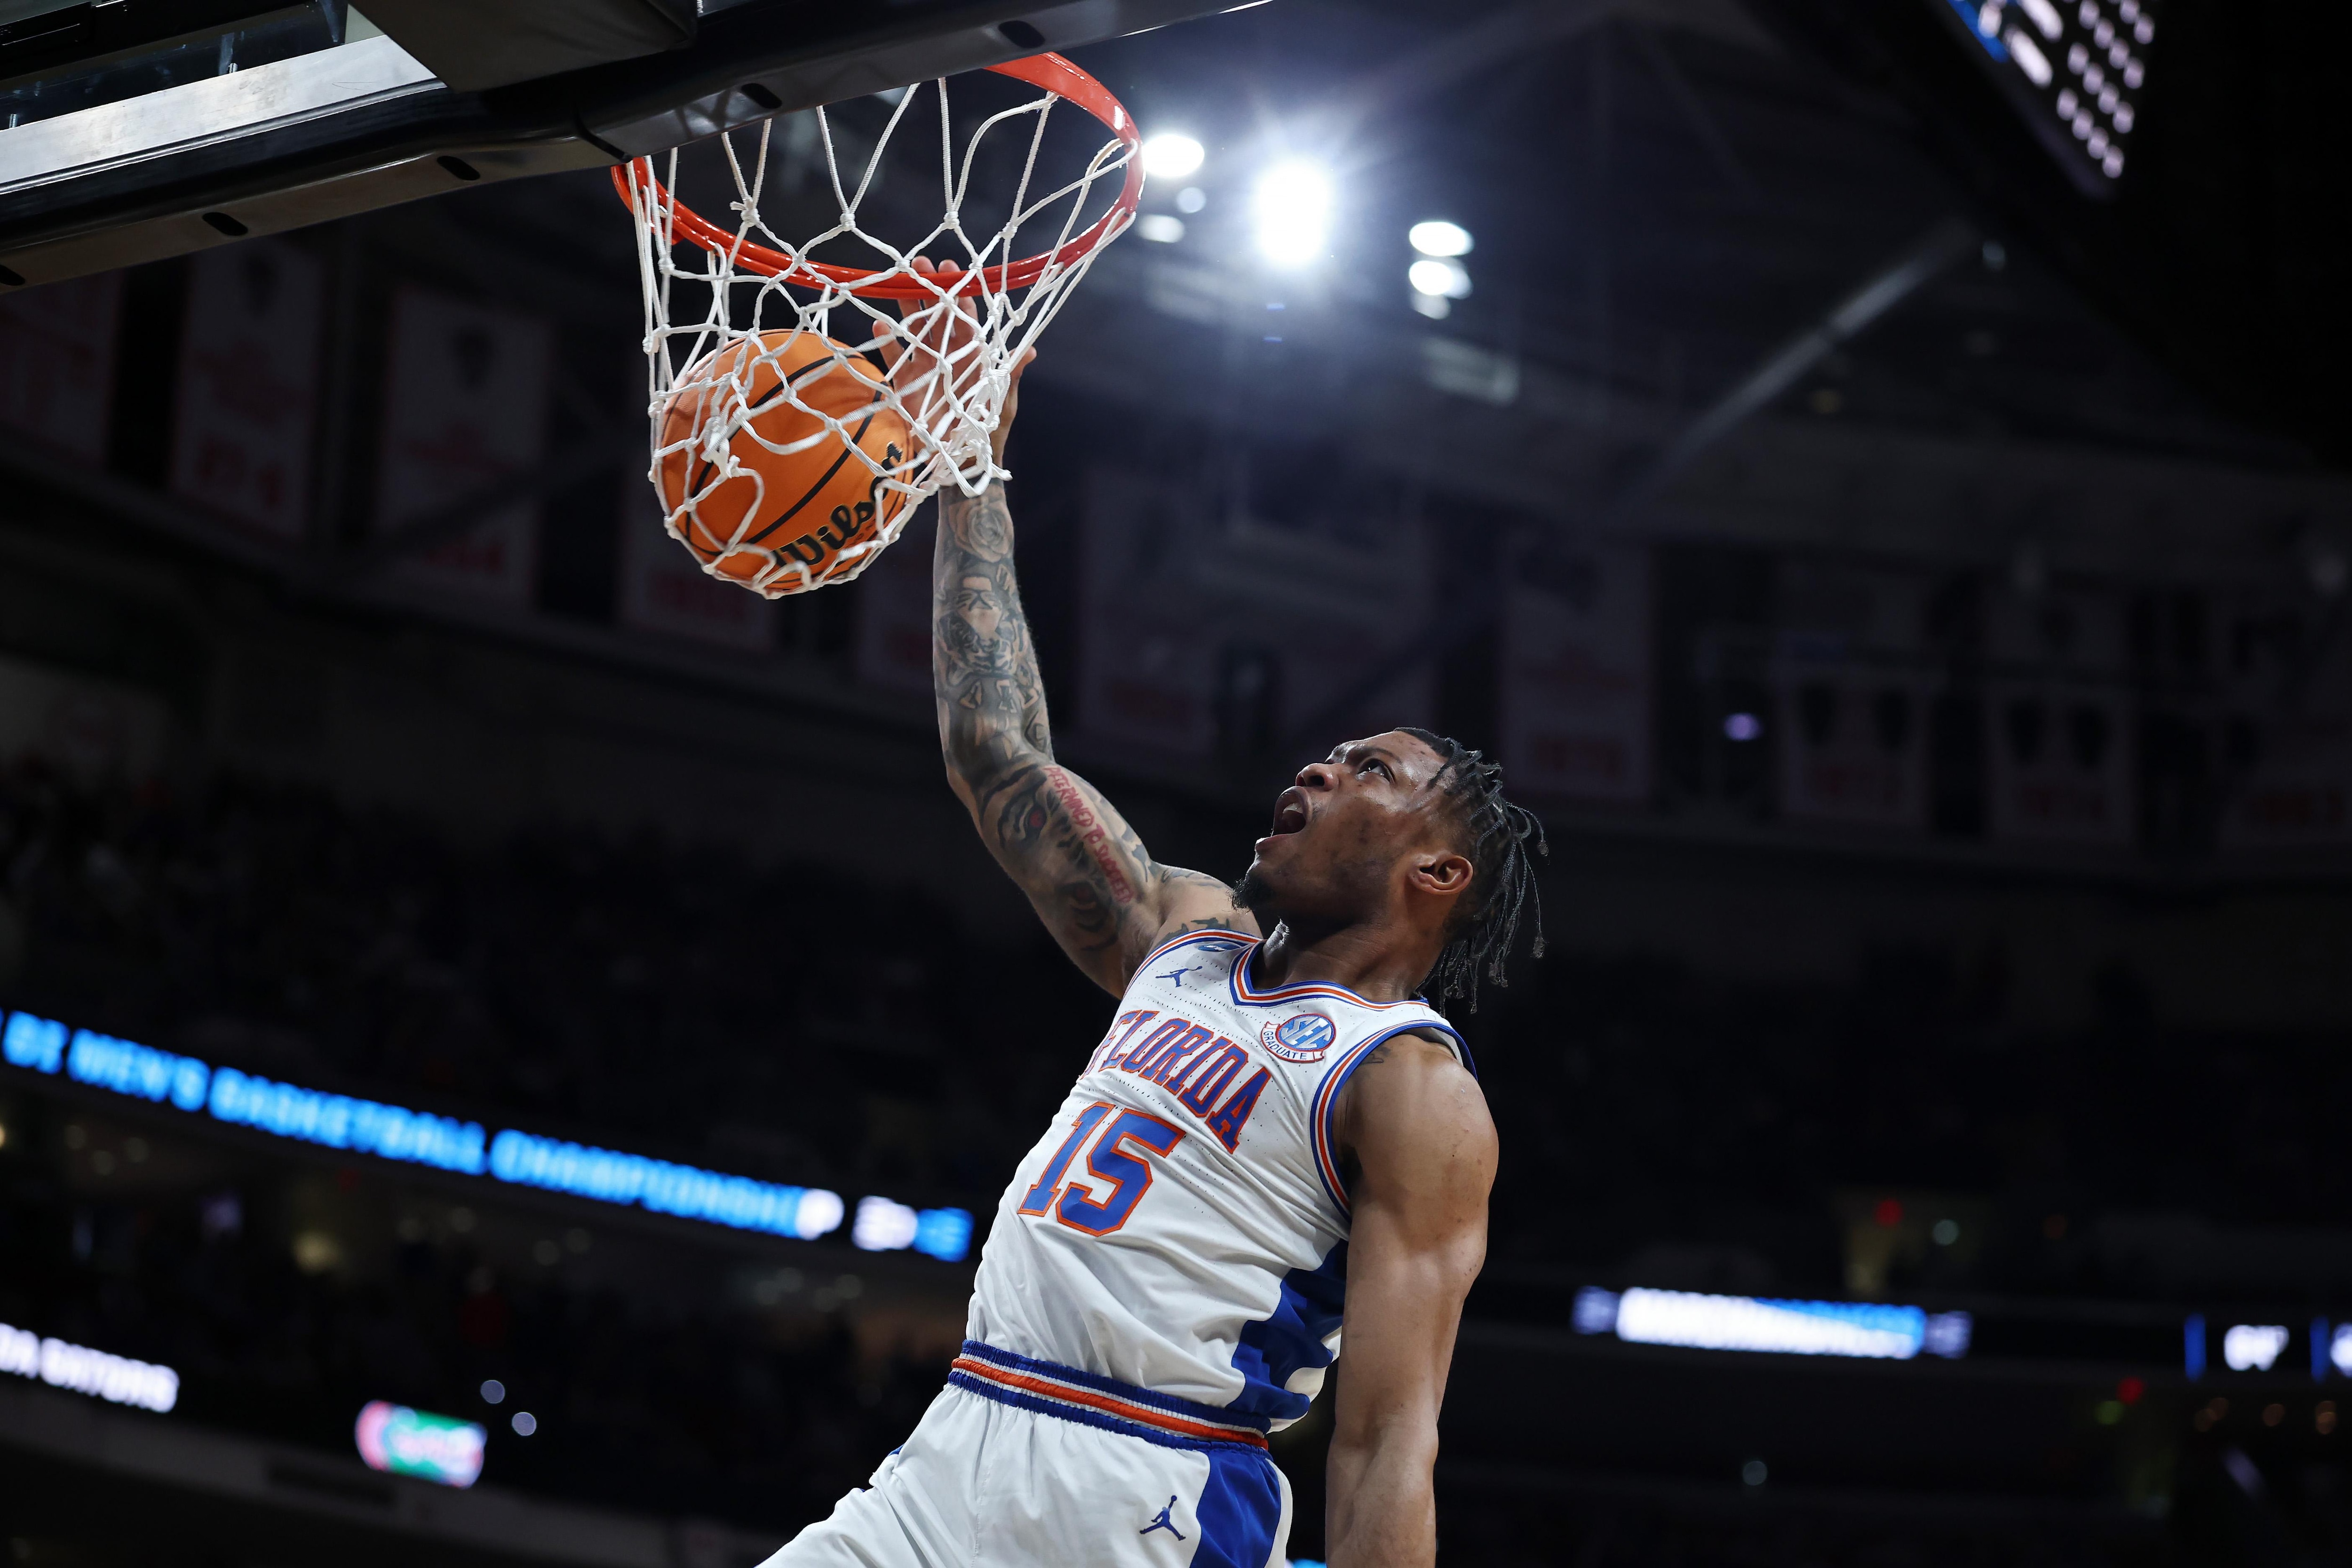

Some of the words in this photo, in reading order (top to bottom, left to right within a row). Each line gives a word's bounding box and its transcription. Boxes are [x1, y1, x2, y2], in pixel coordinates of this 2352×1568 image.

[771, 440, 904, 568] Wilson
[1079, 1009, 1271, 1155] FLORIDA
[1263, 1030, 1308, 1060] GRADUATE
[1280, 1015, 1332, 1049] SEC
[1017, 1101, 1187, 1237] 15
